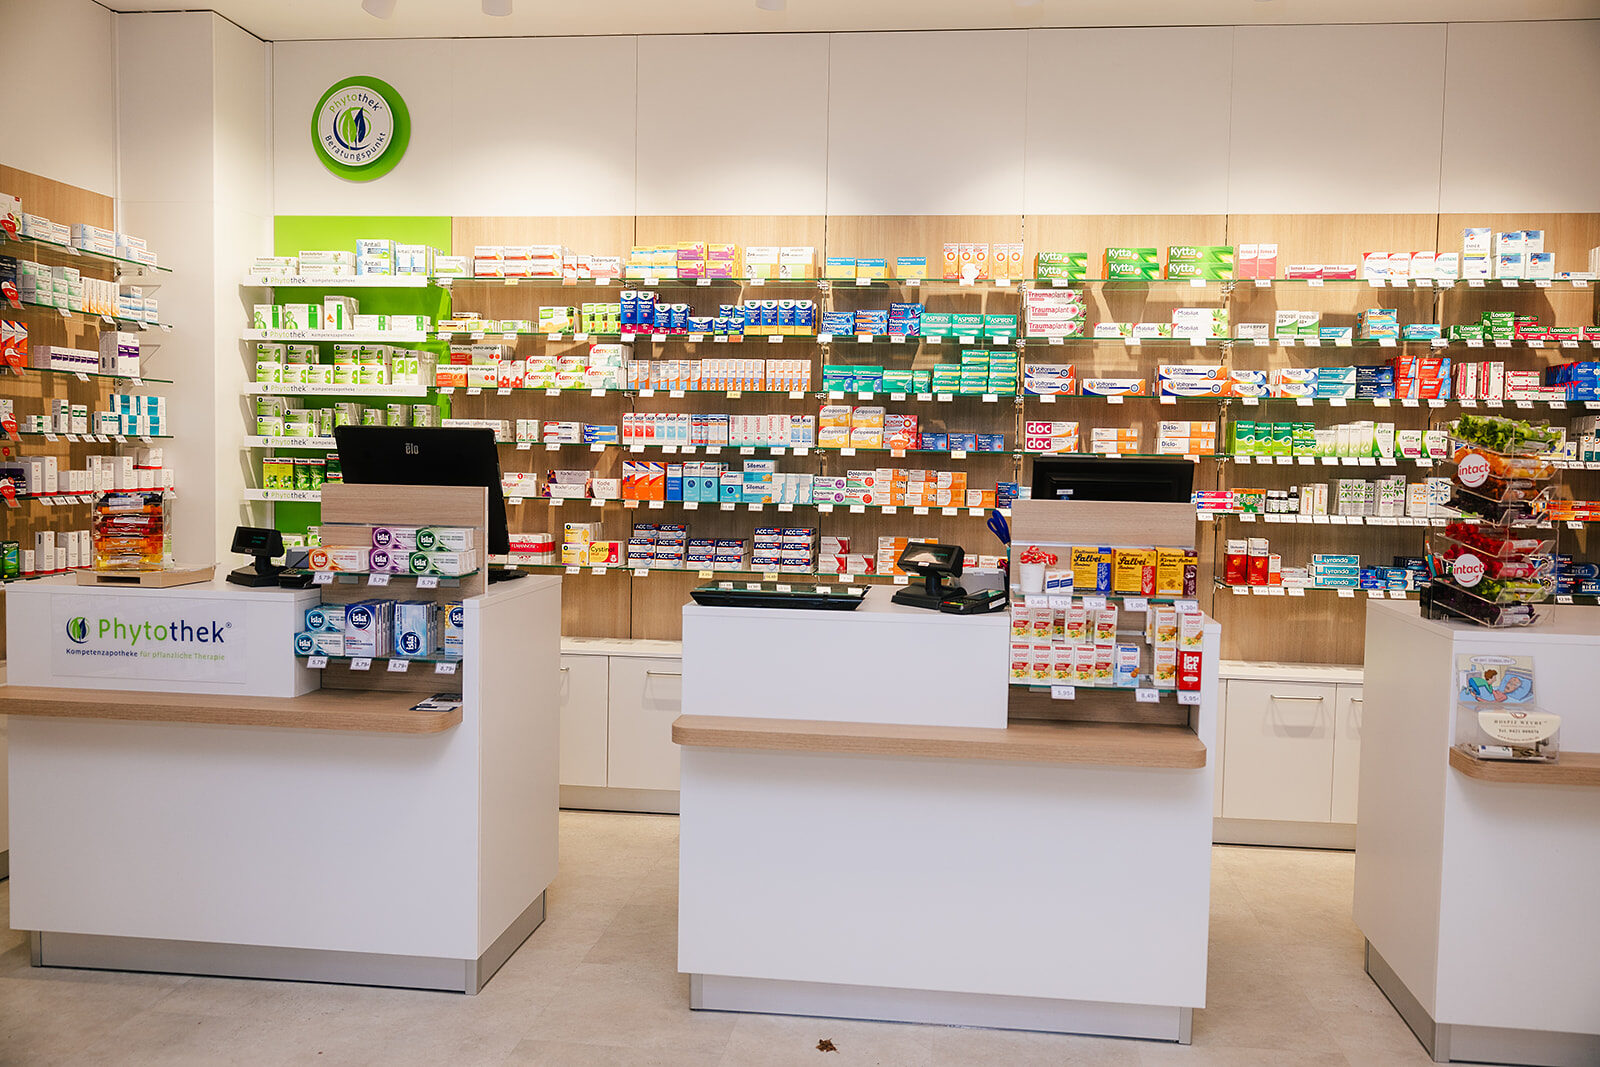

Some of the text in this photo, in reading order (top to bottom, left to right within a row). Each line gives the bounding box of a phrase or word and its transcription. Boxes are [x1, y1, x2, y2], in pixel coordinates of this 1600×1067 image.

[325, 132, 386, 162] Beratungspunkt
[1108, 249, 1132, 258] Kytta
[1171, 247, 1196, 257] Kytta
[1039, 253, 1063, 261] Kytta
[1038, 267, 1061, 275] Kytta
[1110, 264, 1134, 273] Kytta
[1169, 264, 1194, 273] Kytta
[1028, 291, 1066, 299] Traumaplant
[1031, 306, 1069, 314] Traumaplant
[1027, 423, 1050, 434] doc
[1027, 438, 1050, 449] doc
[1459, 464, 1489, 475] intact
[377, 534, 390, 542] isla
[420, 535, 434, 543] isla
[414, 558, 428, 566] isla
[1453, 564, 1483, 574] intact
[352, 613, 367, 622] isla
[298, 639, 311, 647] isla
[65, 648, 138, 657] Kompetenzapotheke
[194, 653, 225, 661] Therapie
